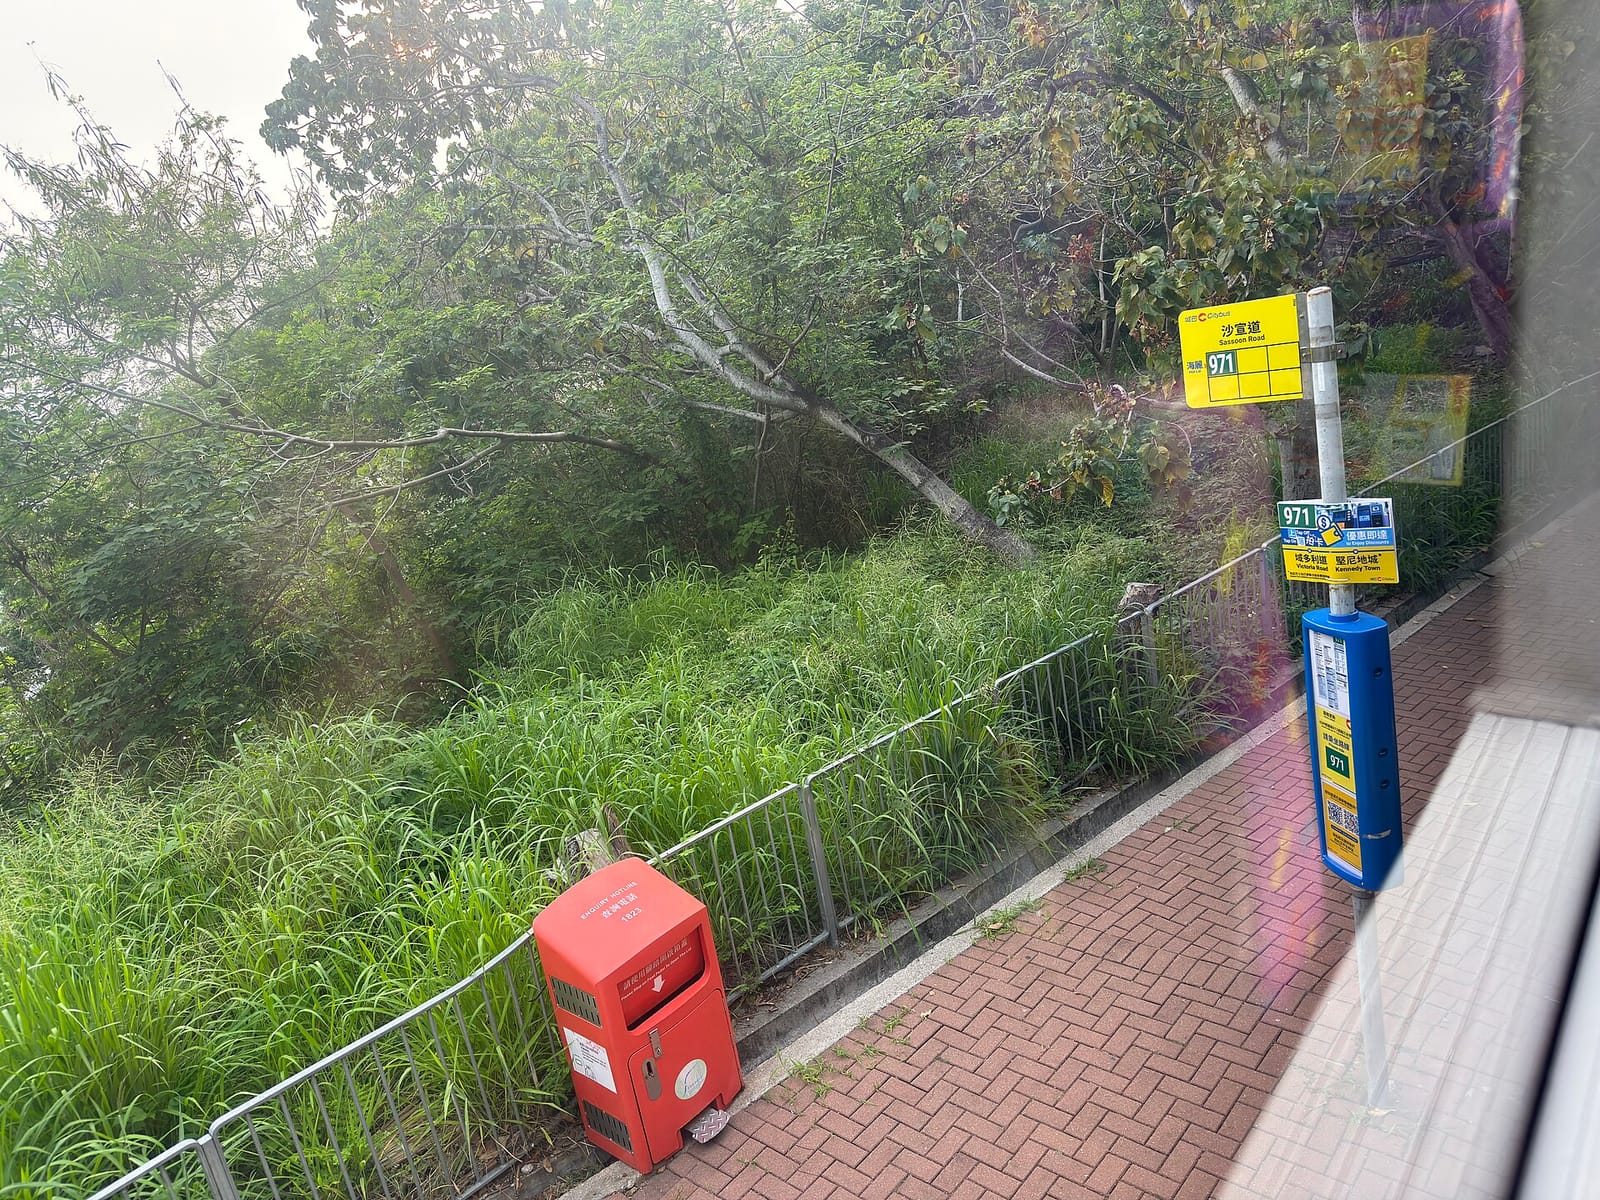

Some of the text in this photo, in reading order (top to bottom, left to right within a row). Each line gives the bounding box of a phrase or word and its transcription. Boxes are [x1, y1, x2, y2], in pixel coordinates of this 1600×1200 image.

[1221, 320, 1262, 337] 沙宣道
[1219, 334, 1266, 346] Sassoon Road
[1208, 352, 1234, 375] 971
[1283, 507, 1309, 526] 971
[1330, 754, 1345, 771] 971
[580, 881, 638, 920] ENQUIRY HOTLINE
[621, 907, 642, 922] 1823
